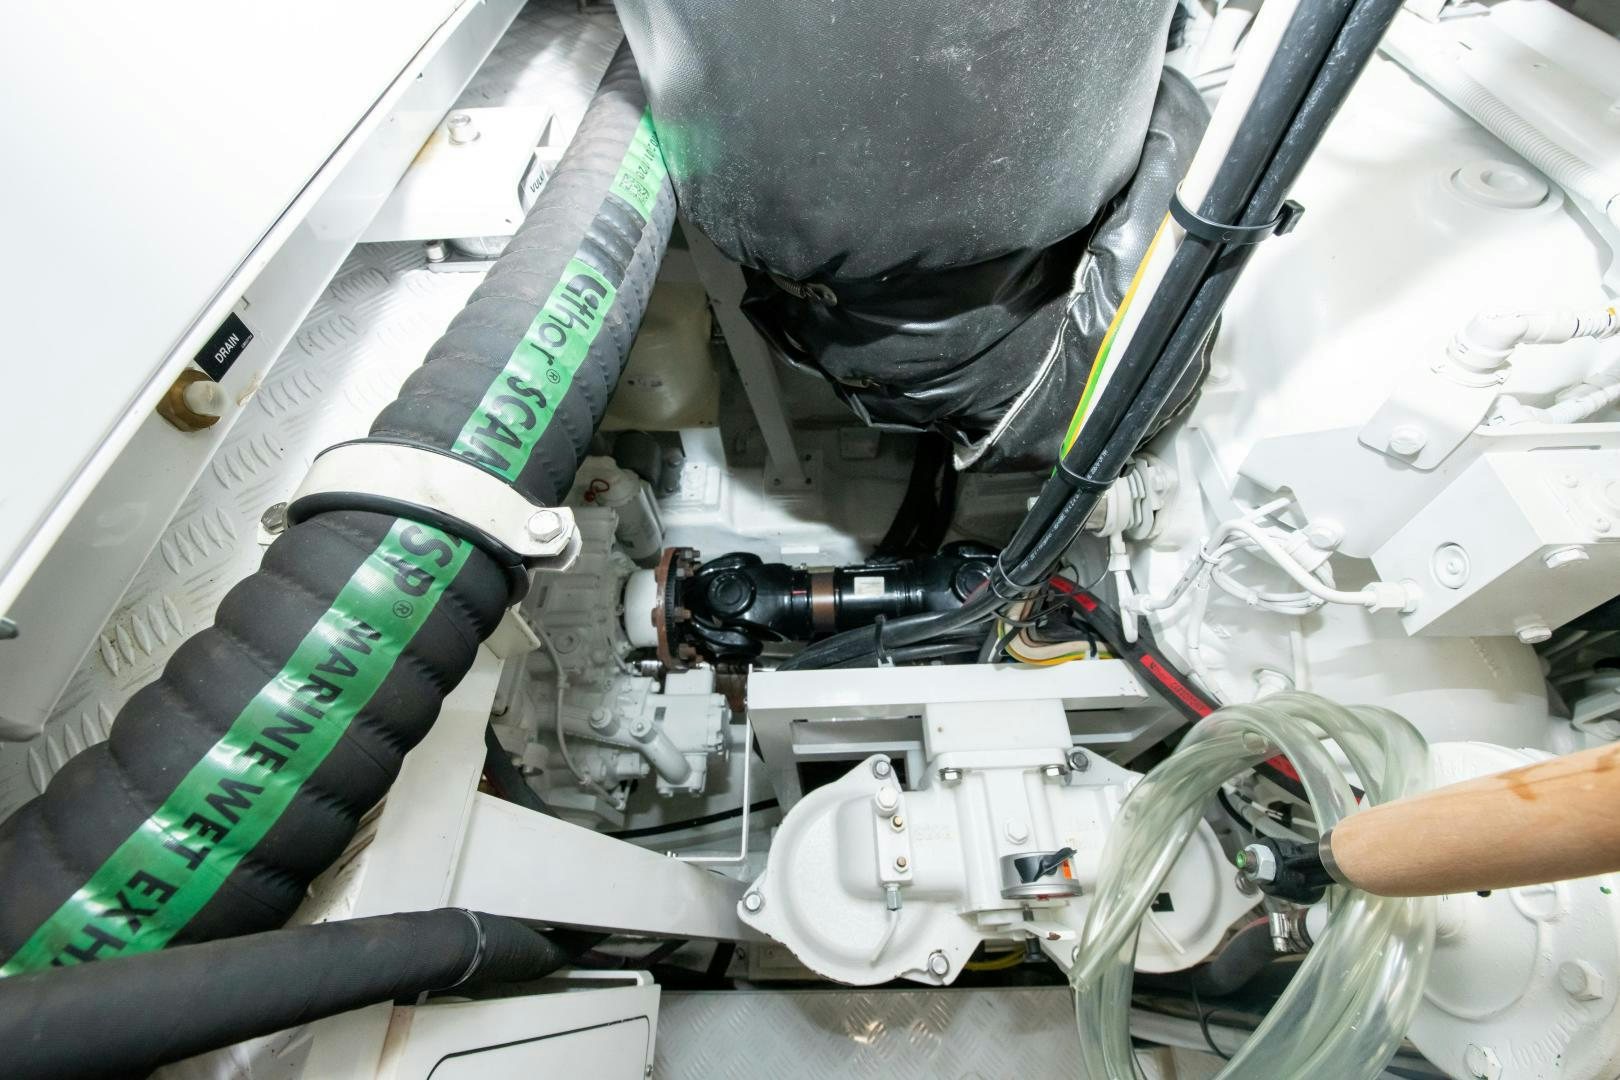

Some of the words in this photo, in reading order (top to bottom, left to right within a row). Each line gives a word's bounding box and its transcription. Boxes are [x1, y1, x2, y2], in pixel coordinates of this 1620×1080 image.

[214, 332, 240, 364] DRAIN
[243, 616, 382, 774] MARINE
[162, 778, 265, 871] WET
[51, 869, 180, 967] EXH
